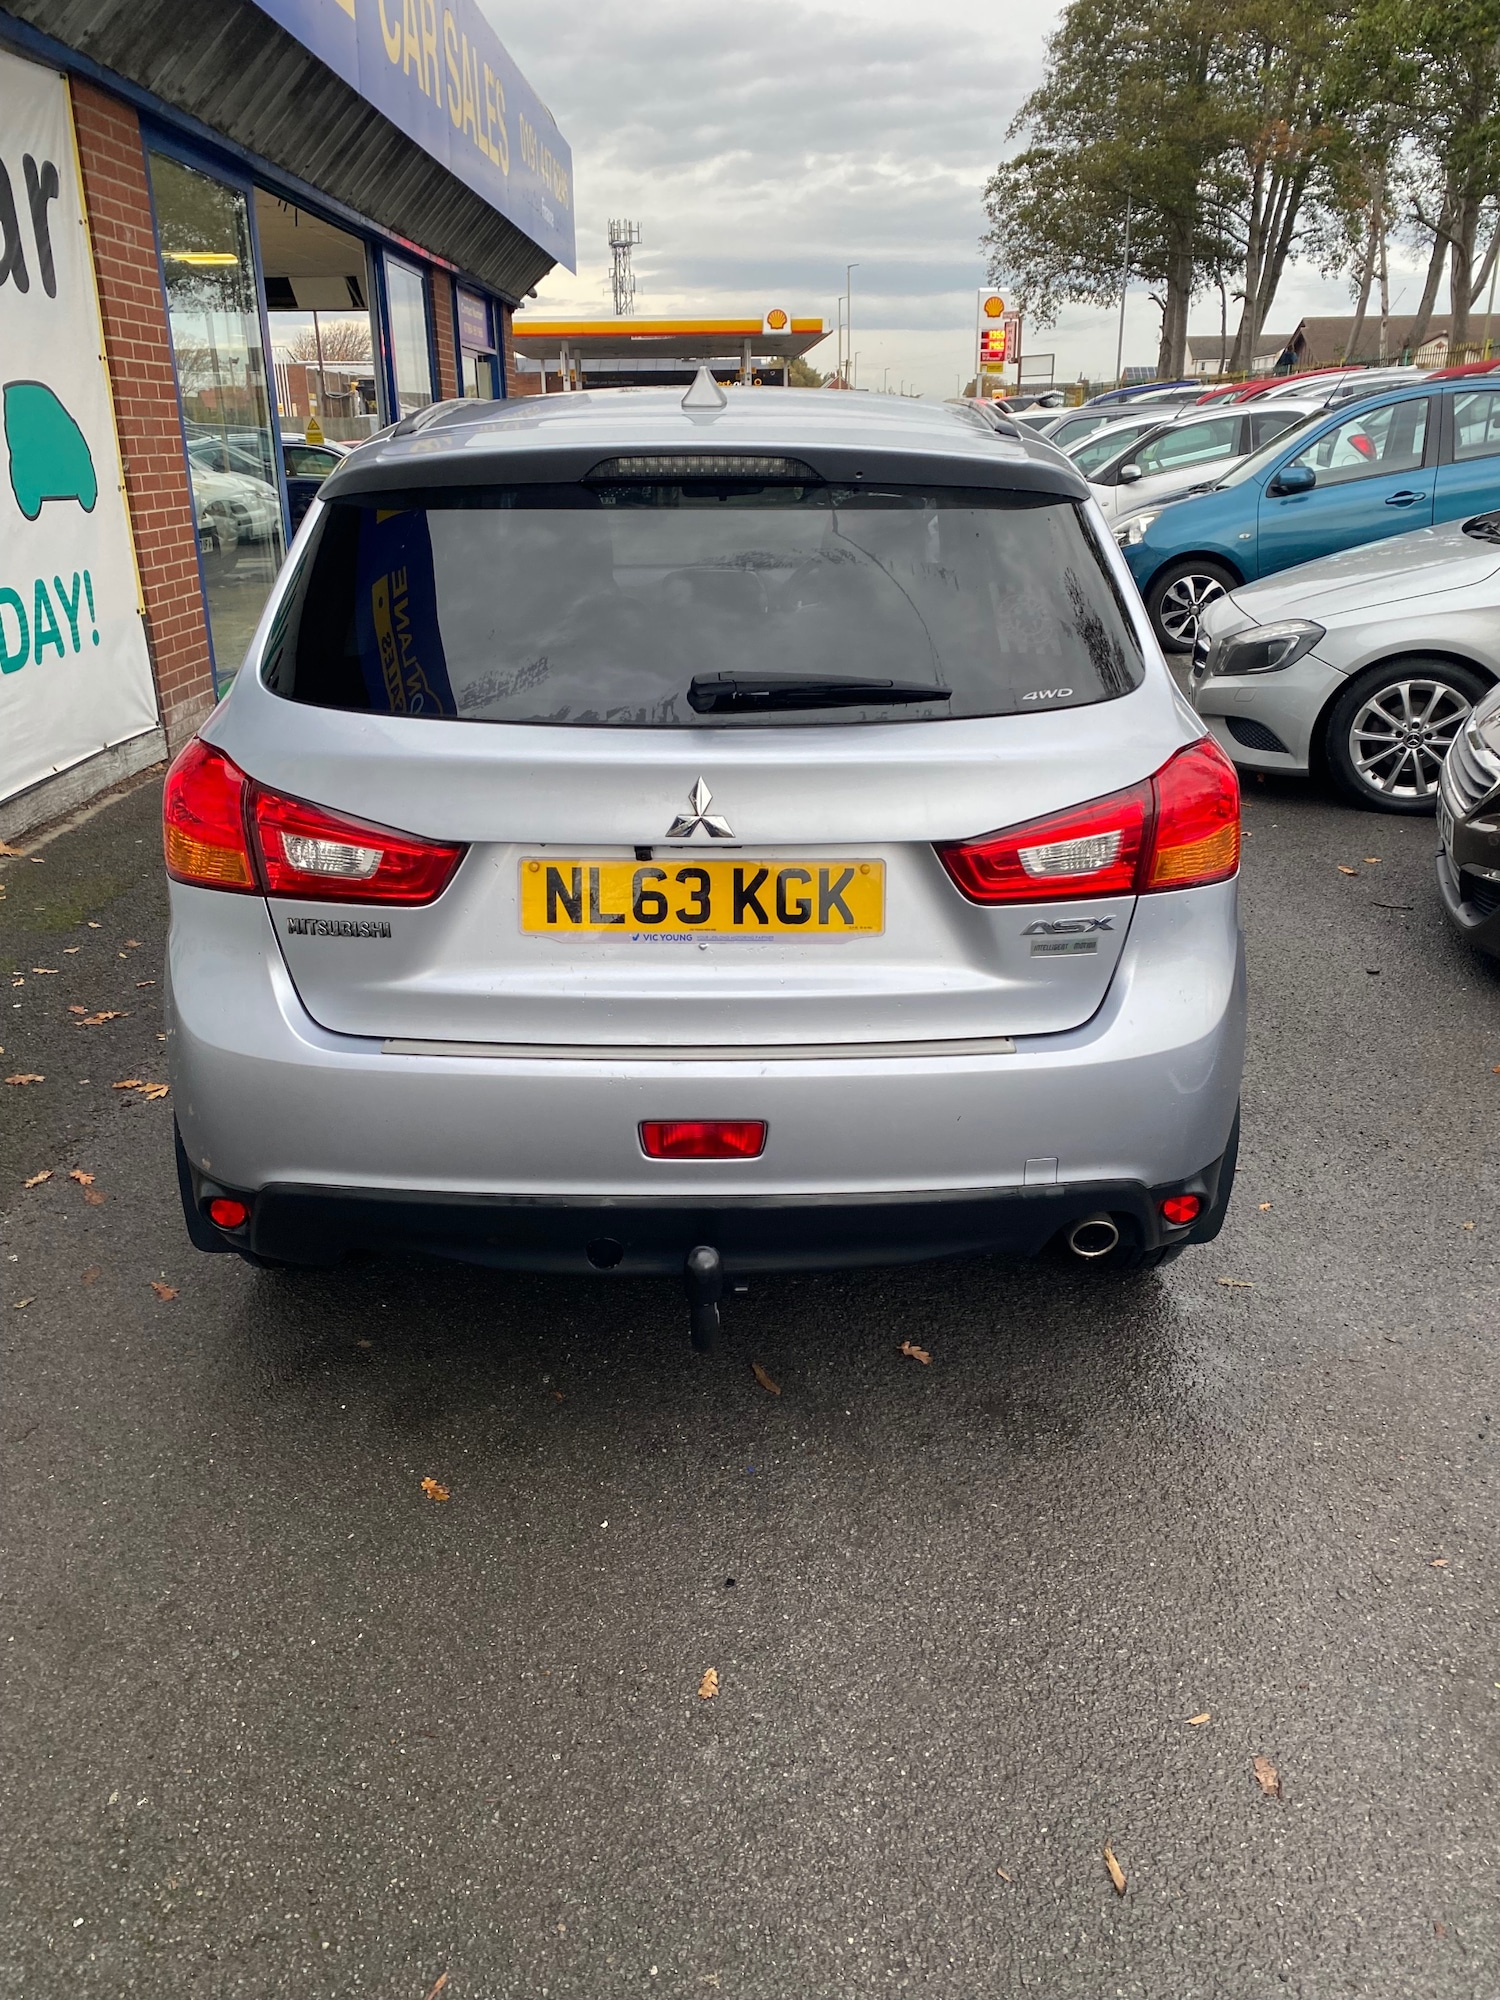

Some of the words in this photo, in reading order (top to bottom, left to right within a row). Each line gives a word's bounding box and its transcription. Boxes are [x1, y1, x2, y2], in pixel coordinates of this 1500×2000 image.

[443, 7, 510, 177] SALES
[0, 569, 100, 675] DAY!
[1022, 687, 1073, 700] 4WD
[546, 866, 711, 924] NL63
[733, 867, 855, 925] KGK
[287, 917, 392, 938] MITSUBISHI
[1020, 914, 1117, 936] ASX
[643, 933, 658, 941] VIC
[660, 933, 693, 941] YOUNG
